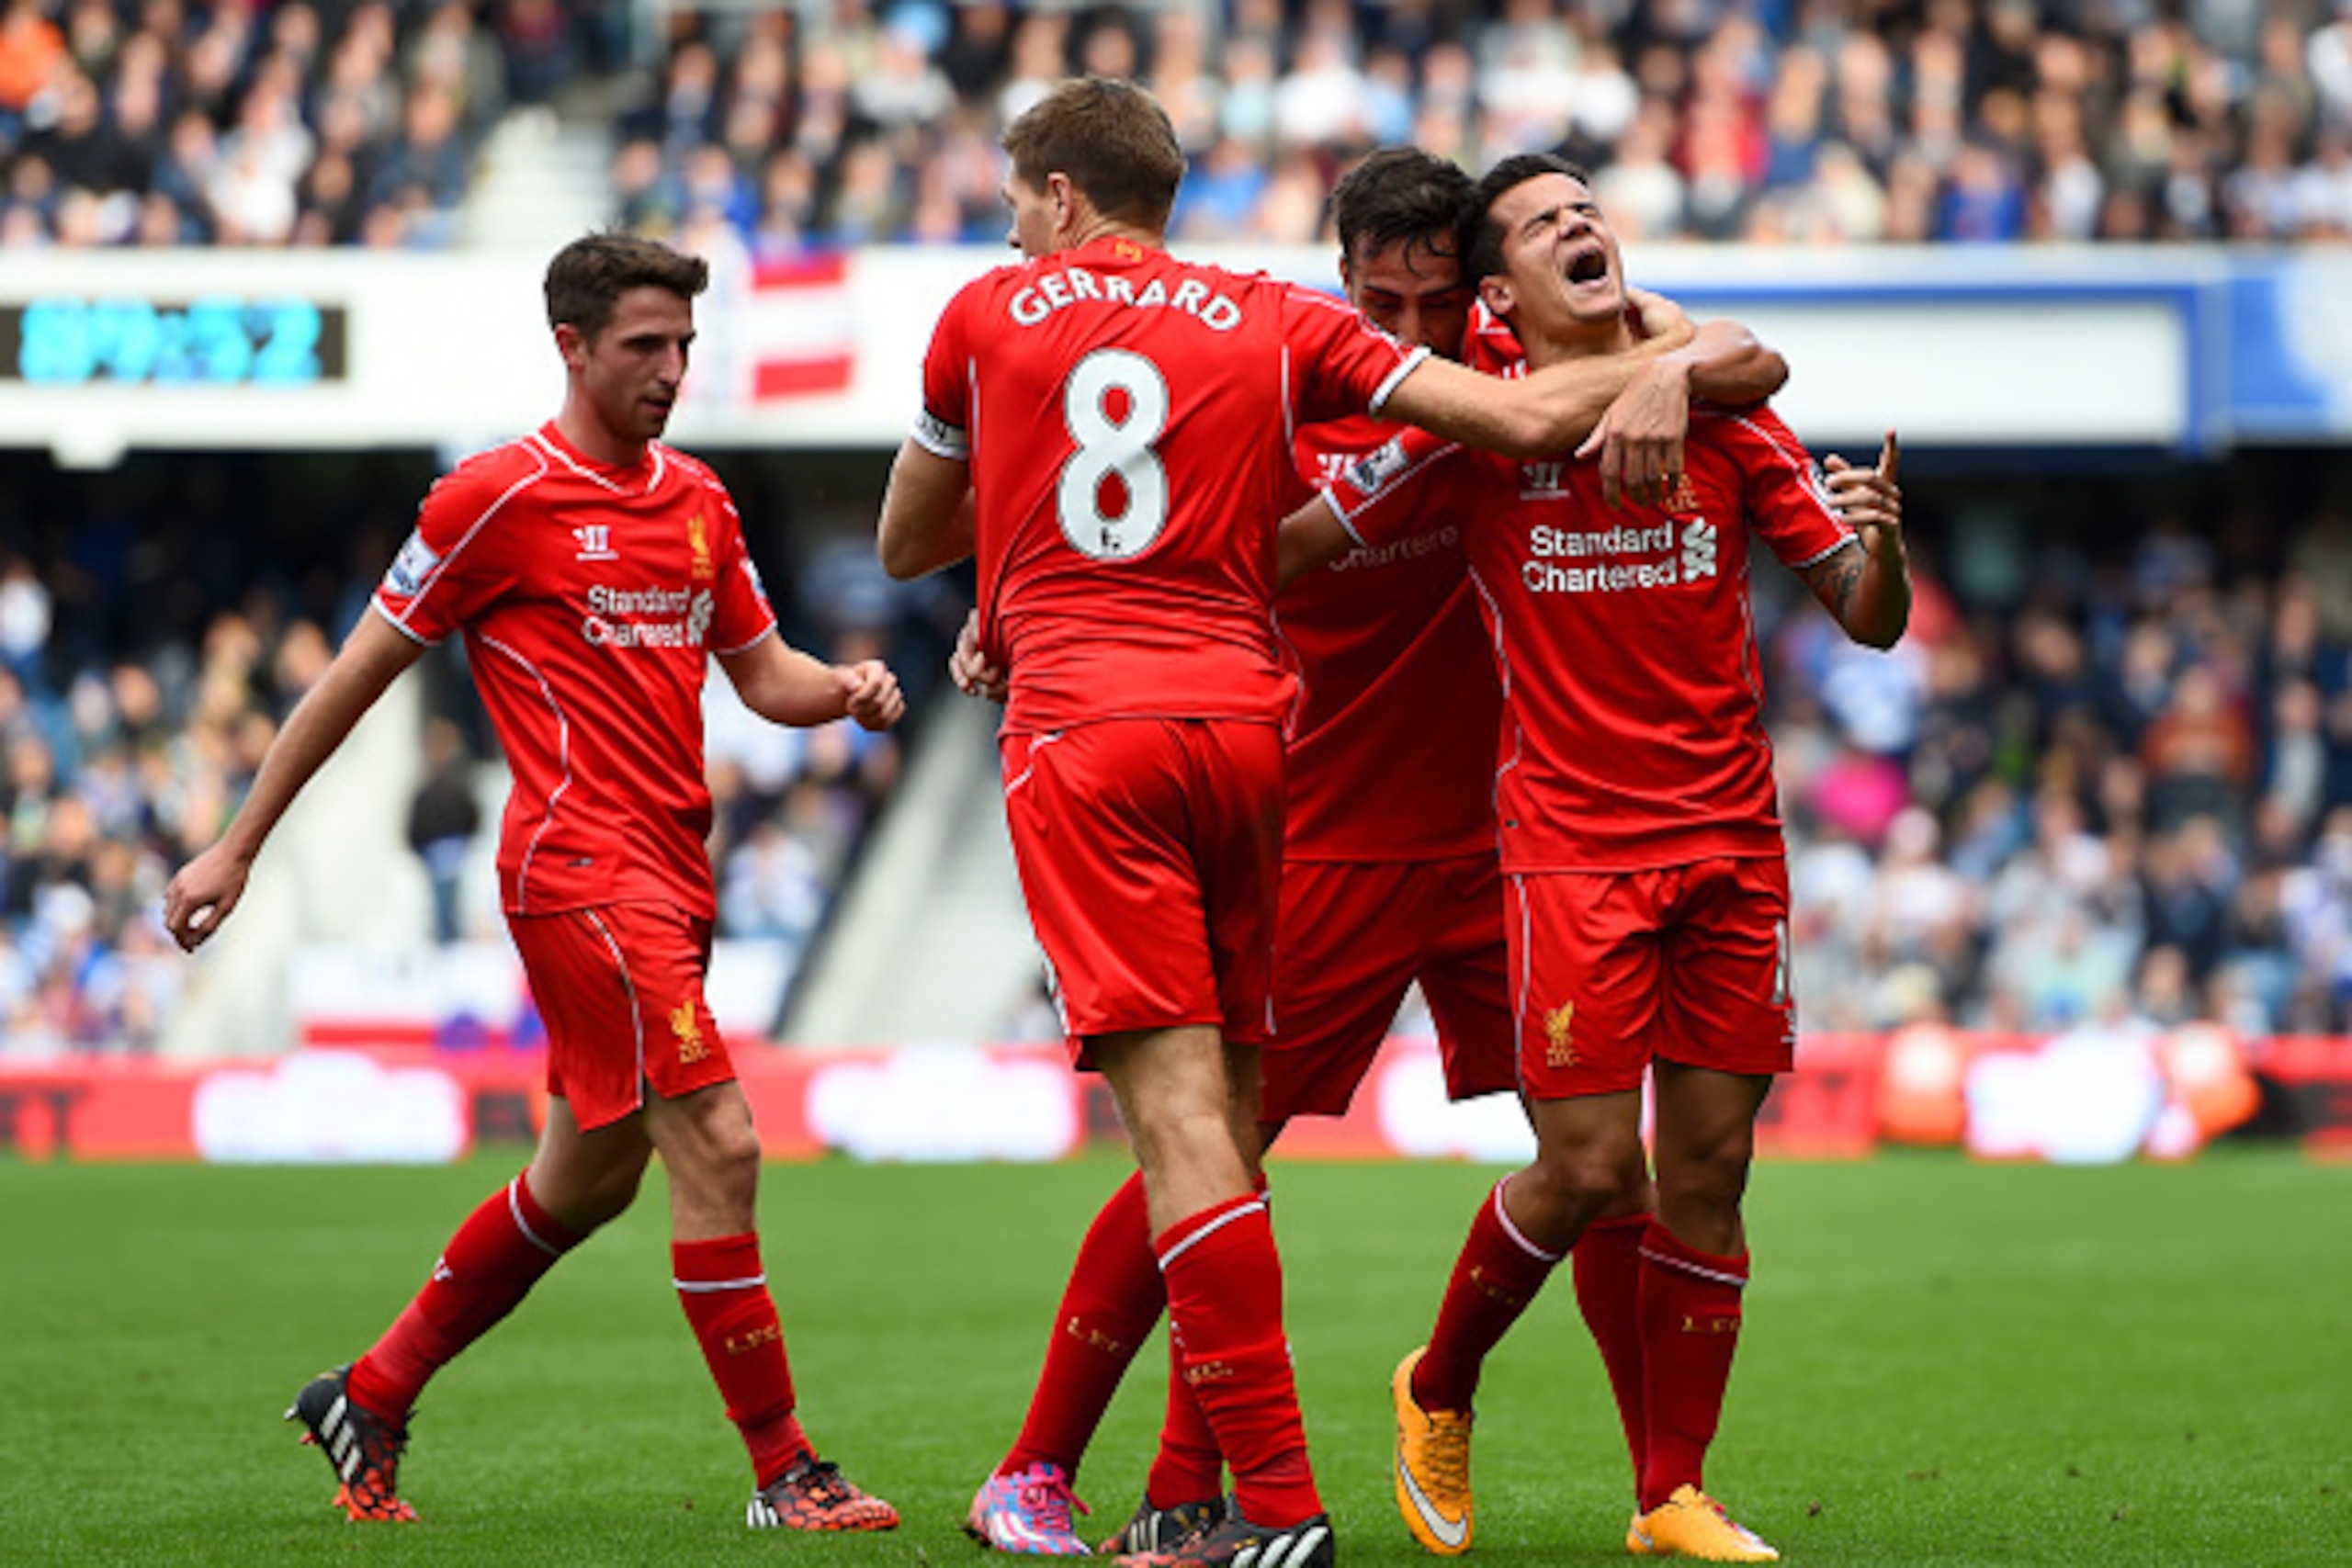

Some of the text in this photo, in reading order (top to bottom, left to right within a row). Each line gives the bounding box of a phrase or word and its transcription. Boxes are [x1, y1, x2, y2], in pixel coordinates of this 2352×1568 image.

[1009, 266, 1242, 332] GERRARD
[1057, 346, 1170, 562] 8
[1530, 511, 1674, 557] Standard
[1521, 556, 1678, 593] Chartered
[588, 583, 691, 615] Standard
